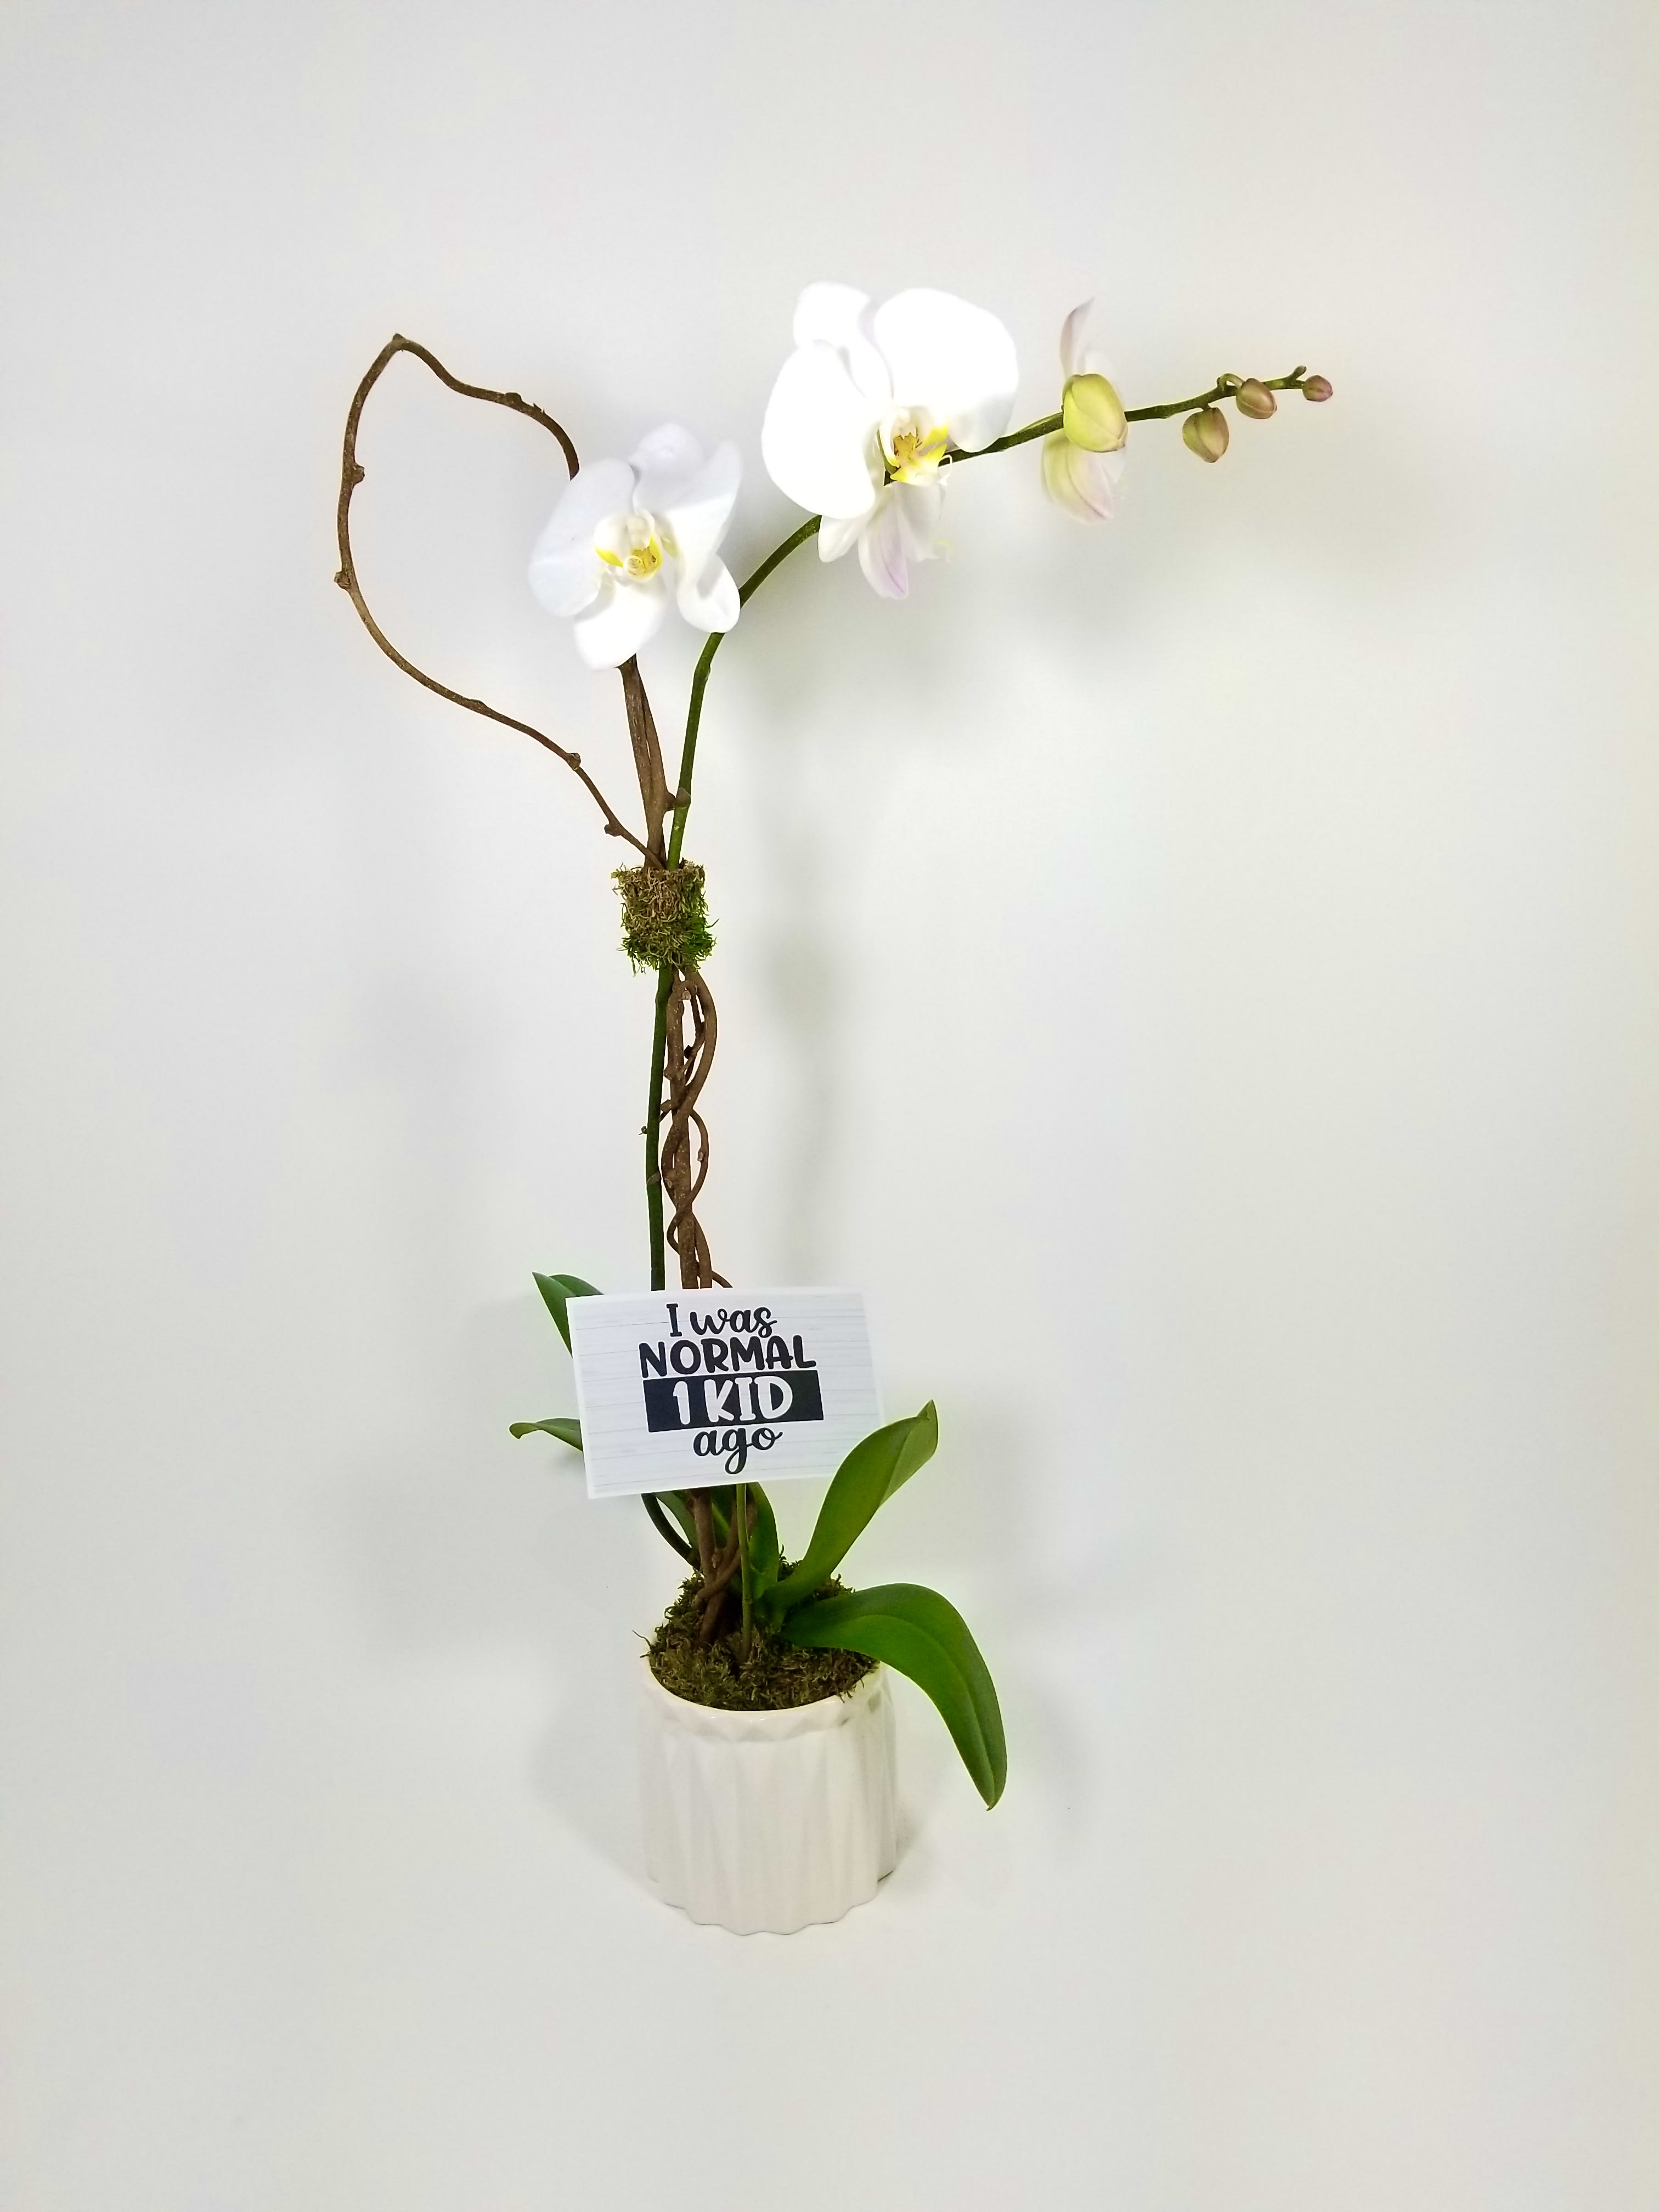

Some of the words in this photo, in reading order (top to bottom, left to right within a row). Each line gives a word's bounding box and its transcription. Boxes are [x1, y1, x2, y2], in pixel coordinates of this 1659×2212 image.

[667, 1304, 682, 1337] I
[690, 1307, 777, 1339] was
[639, 1335, 816, 1378] NORMAL
[673, 1381, 691, 1425] 1
[704, 1376, 793, 1423] KID
[693, 1427, 783, 1475] ago
